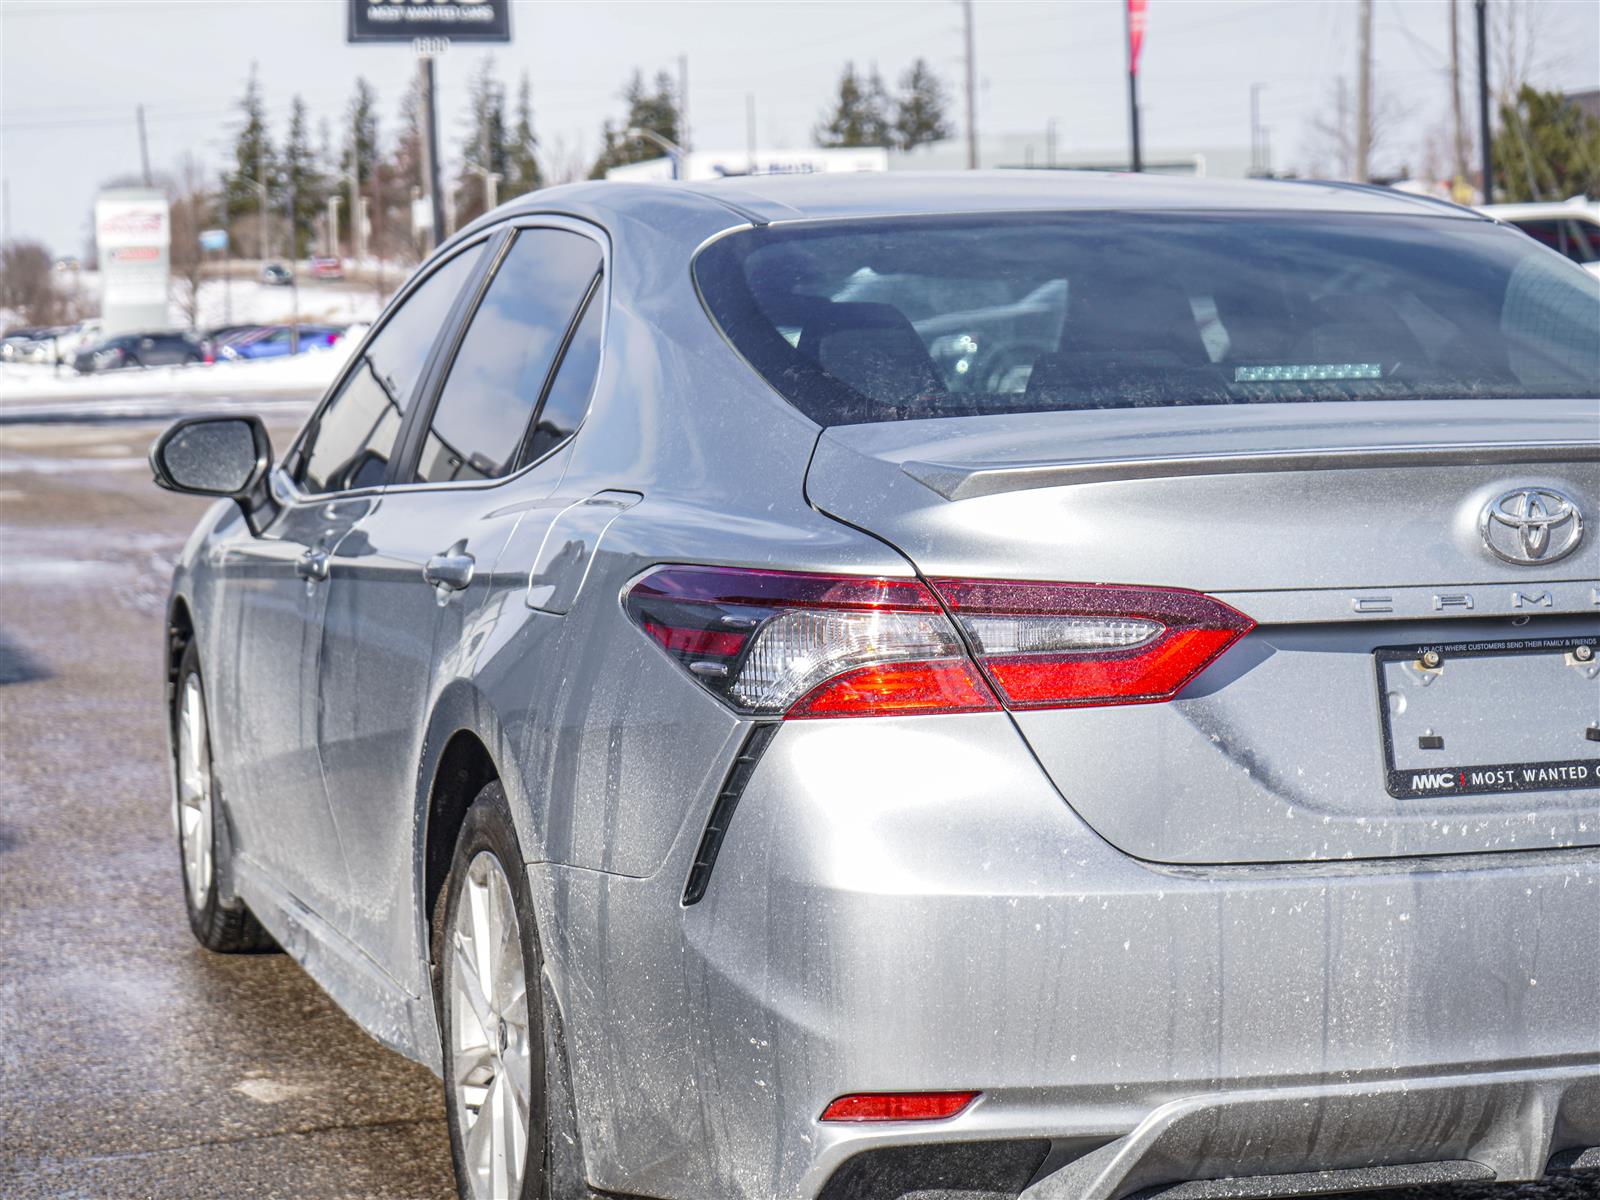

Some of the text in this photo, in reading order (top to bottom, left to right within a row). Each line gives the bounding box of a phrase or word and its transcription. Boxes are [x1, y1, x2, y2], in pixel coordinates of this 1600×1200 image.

[1352, 587, 1600, 613] CAM
[1417, 646, 1423, 654] A
[1445, 644, 1467, 652] WHERE
[1468, 642, 1506, 651] CUSTOMERS
[1506, 641, 1524, 649] SEND
[1525, 640, 1542, 648] THEIR
[1543, 639, 1564, 647] FAMILY
[1571, 637, 1597, 646] FRIENDS
[1472, 770, 1514, 785] MOST
[1523, 766, 1588, 782] WANTED
